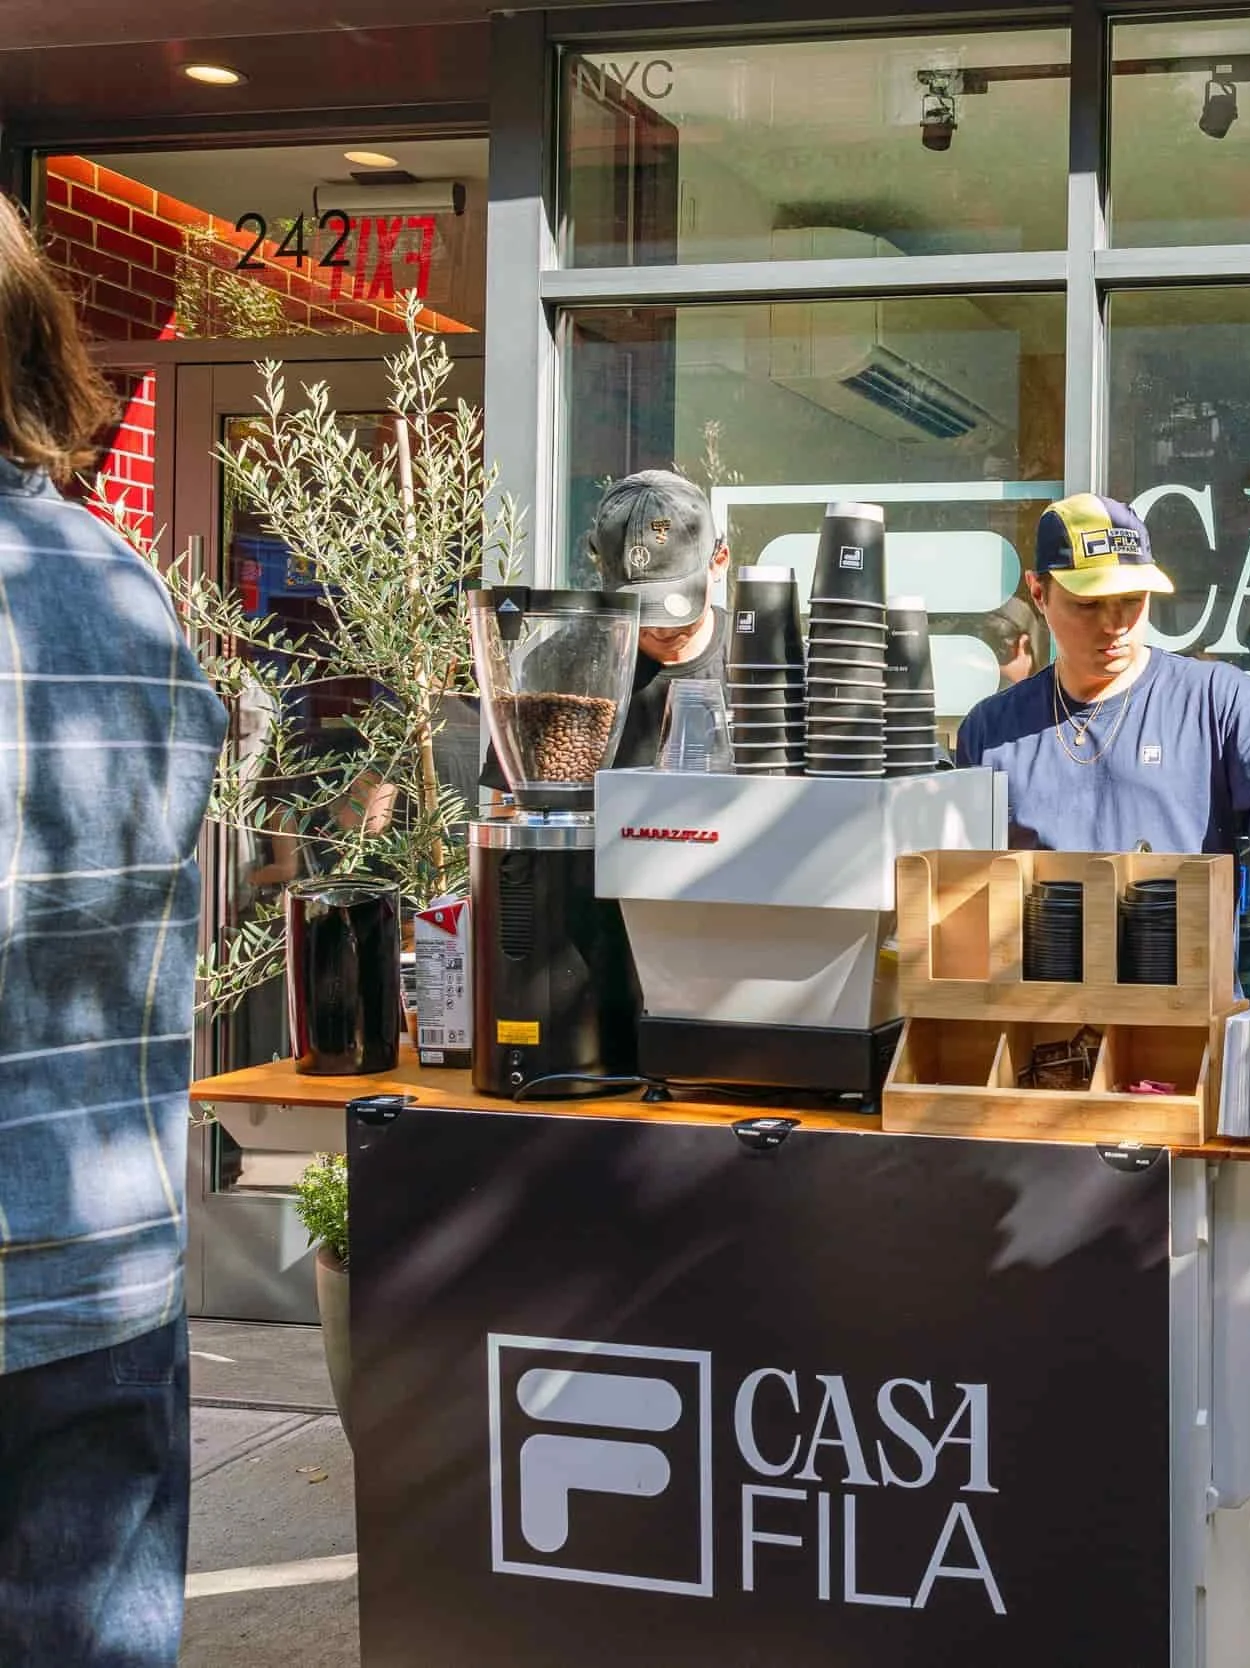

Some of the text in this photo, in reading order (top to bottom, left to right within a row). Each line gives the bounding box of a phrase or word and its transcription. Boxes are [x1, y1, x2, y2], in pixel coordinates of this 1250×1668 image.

[576, 60, 673, 100] NYC
[235, 209, 351, 270] 242
[1113, 536, 1138, 546] FILA
[734, 1367, 1000, 1494] CASA
[741, 1483, 1007, 1614] FILA
